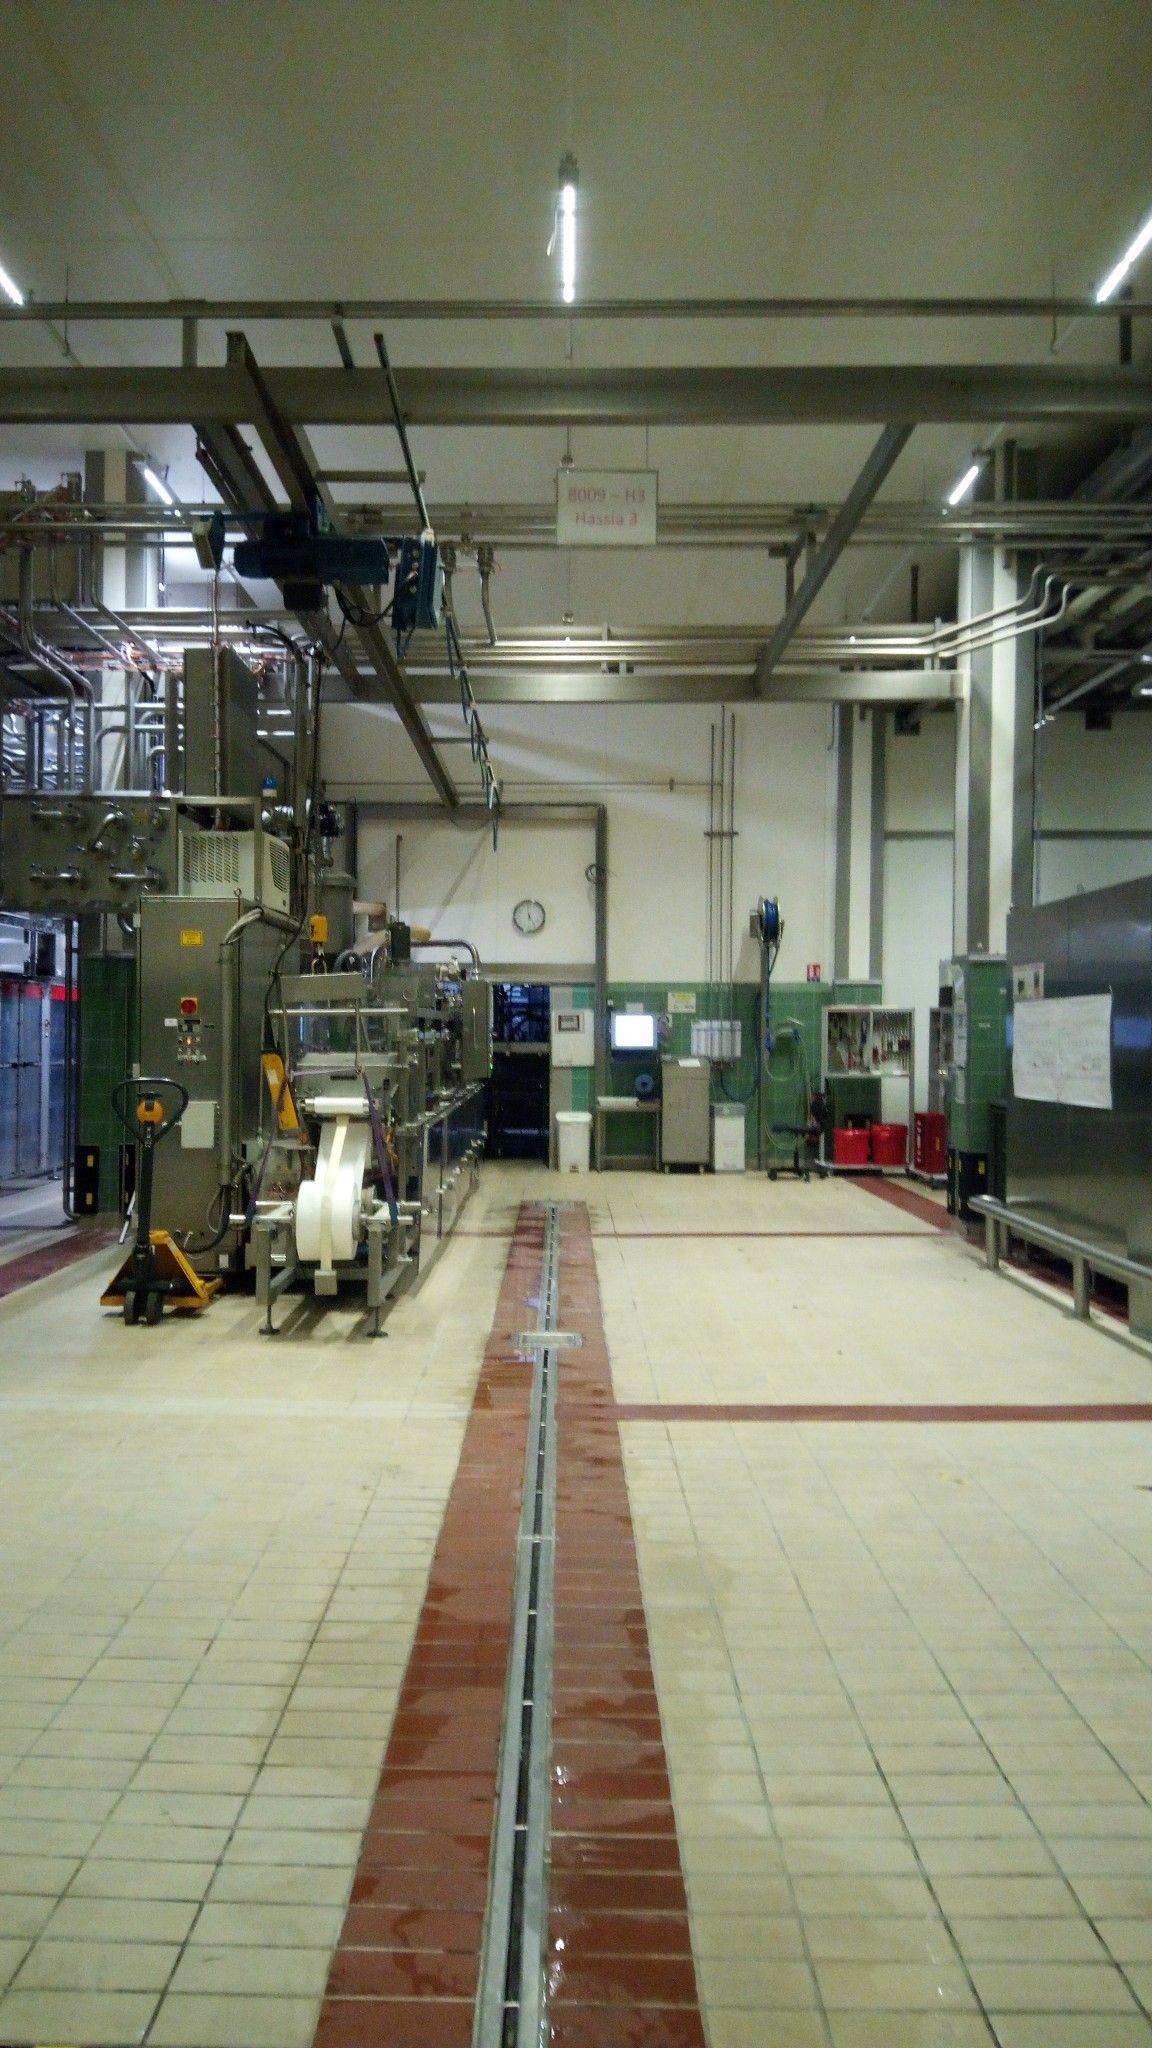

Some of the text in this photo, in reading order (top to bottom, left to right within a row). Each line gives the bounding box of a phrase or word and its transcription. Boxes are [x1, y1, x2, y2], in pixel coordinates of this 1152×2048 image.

[625, 487, 646, 503] H3
[575, 511, 638, 526] Hassia 3
